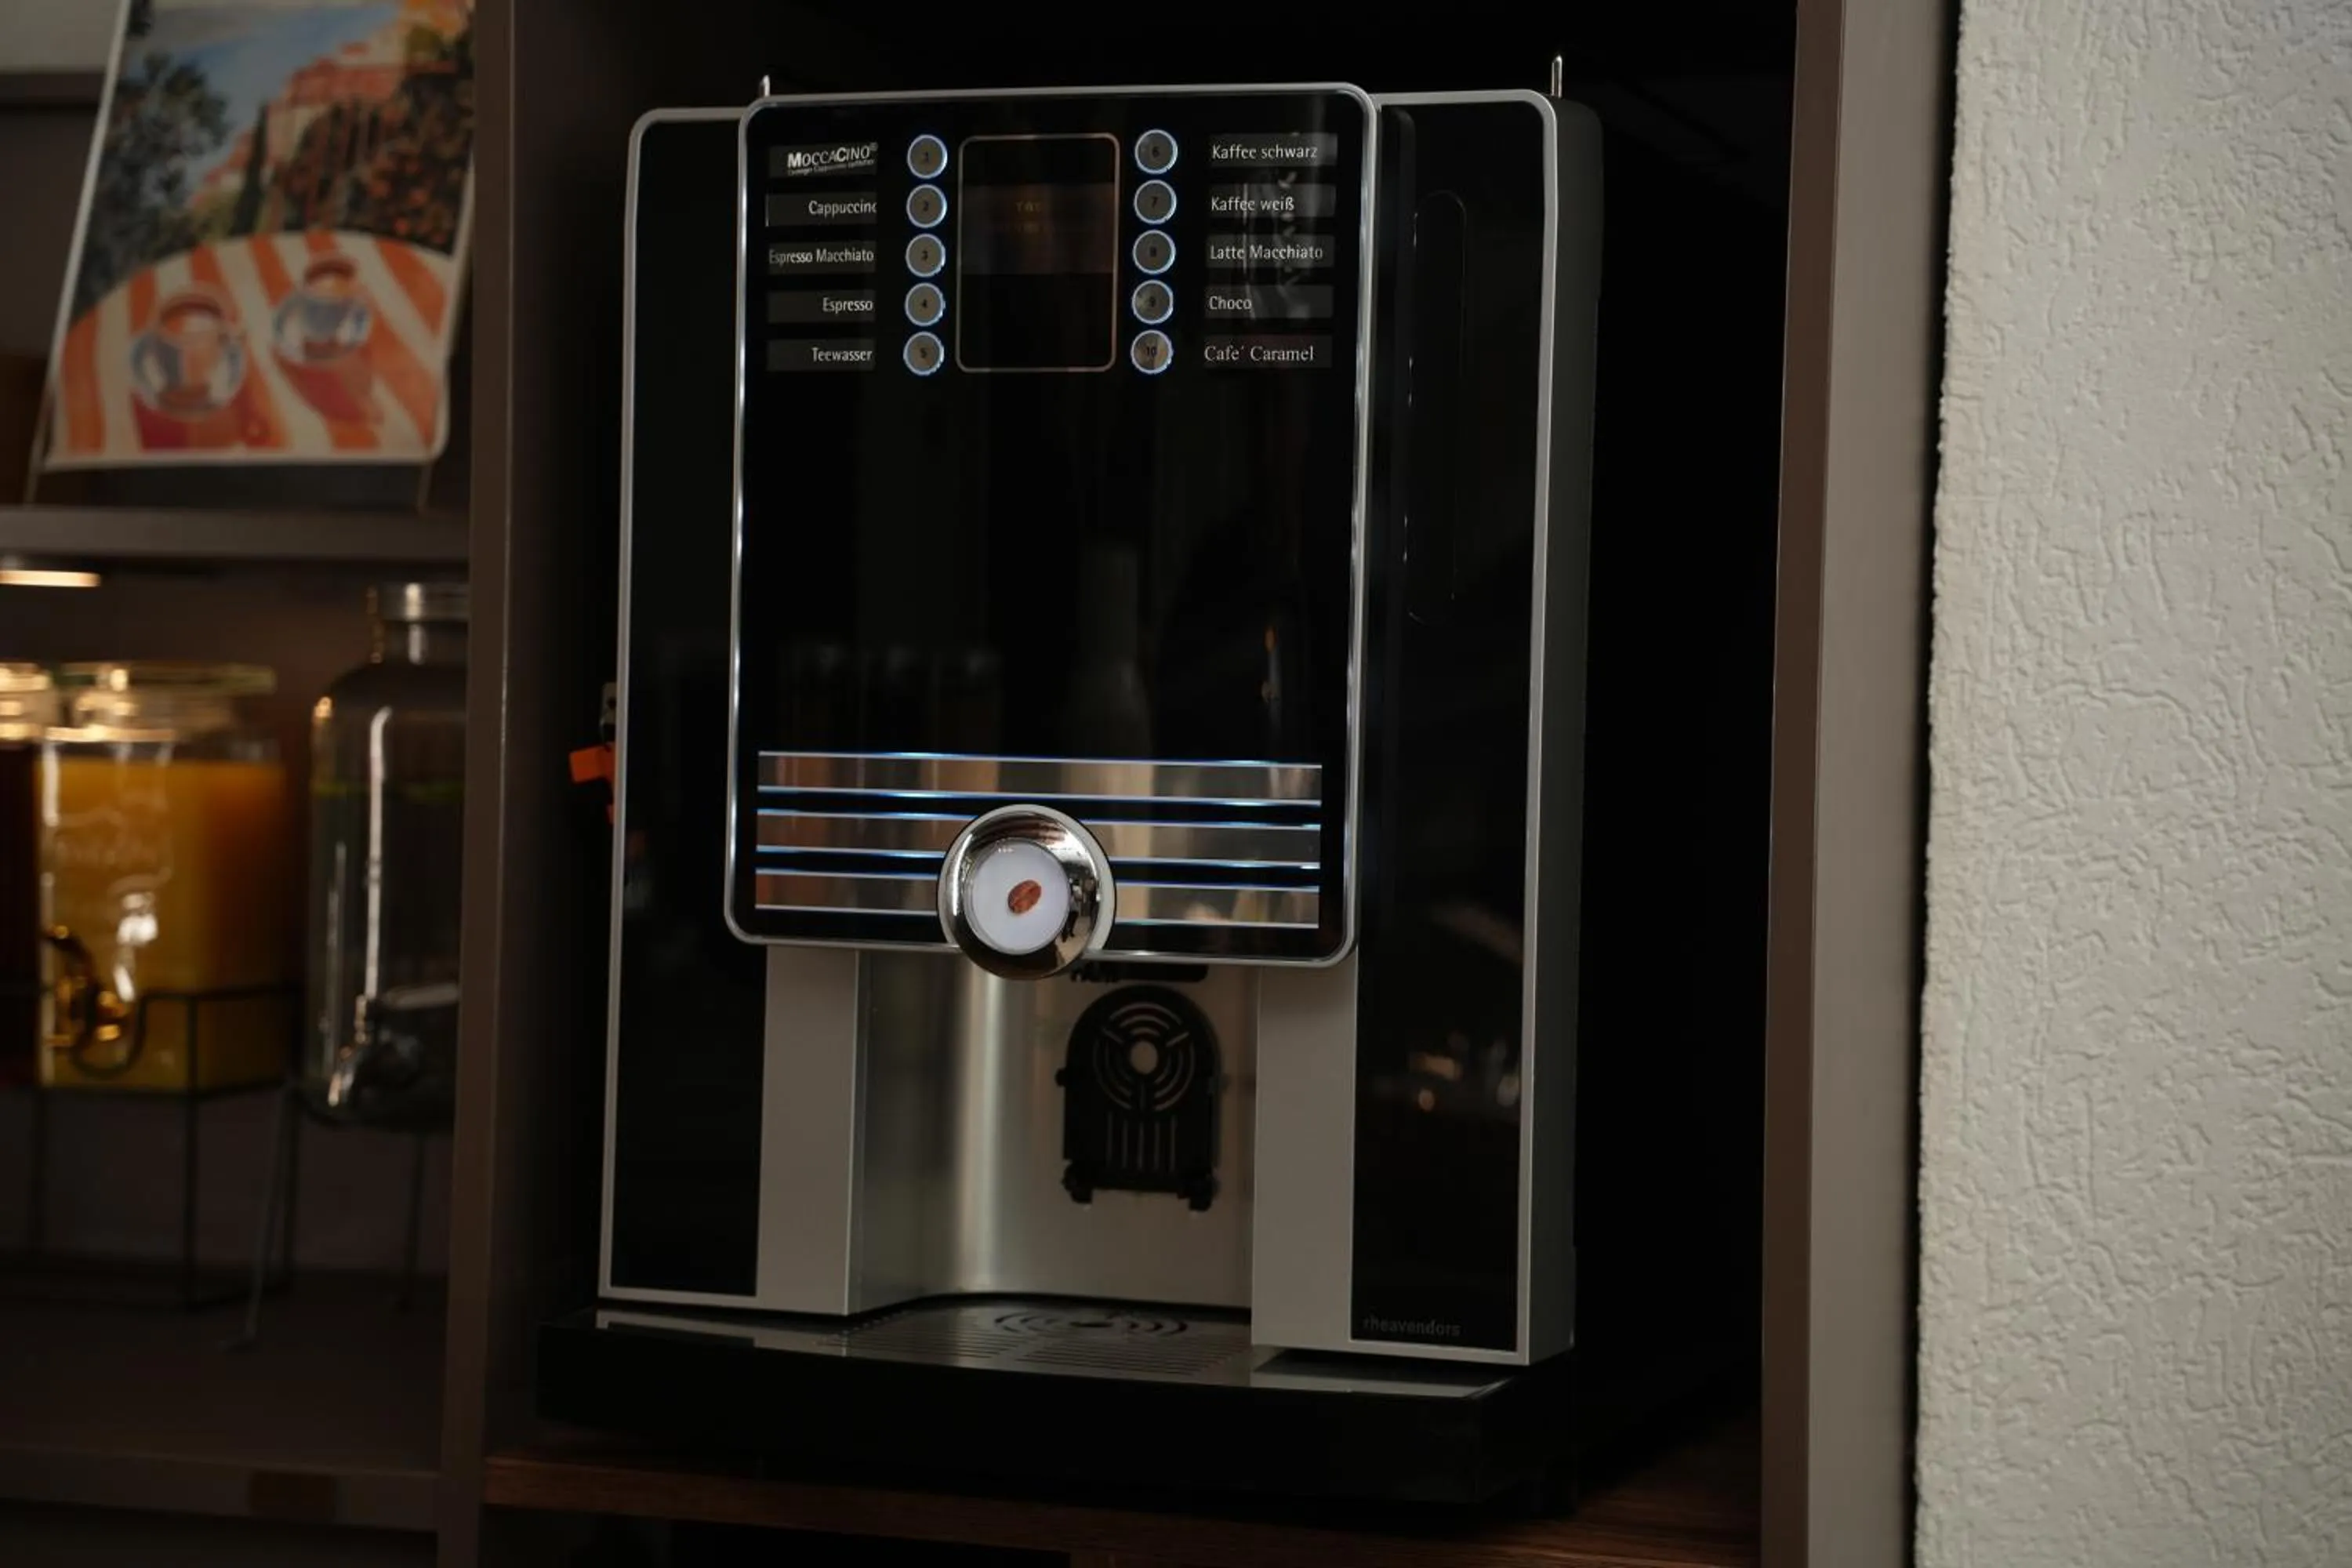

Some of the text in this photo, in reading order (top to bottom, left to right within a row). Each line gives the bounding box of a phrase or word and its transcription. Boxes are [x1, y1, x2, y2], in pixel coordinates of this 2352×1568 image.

[1211, 142, 1318, 160] Kaffee schwarz
[1210, 195, 1295, 212] Kaffee weiß
[768, 248, 875, 266] Espresso Macchiato
[1210, 244, 1323, 260] Latte Macchiato
[822, 296, 874, 314] Espresso
[1208, 295, 1252, 310] Choco
[811, 347, 873, 362] Teewasser
[1145, 347, 1157, 358] 10
[1250, 346, 1315, 361] Caramel
[1363, 1312, 1462, 1338] rheavendors
